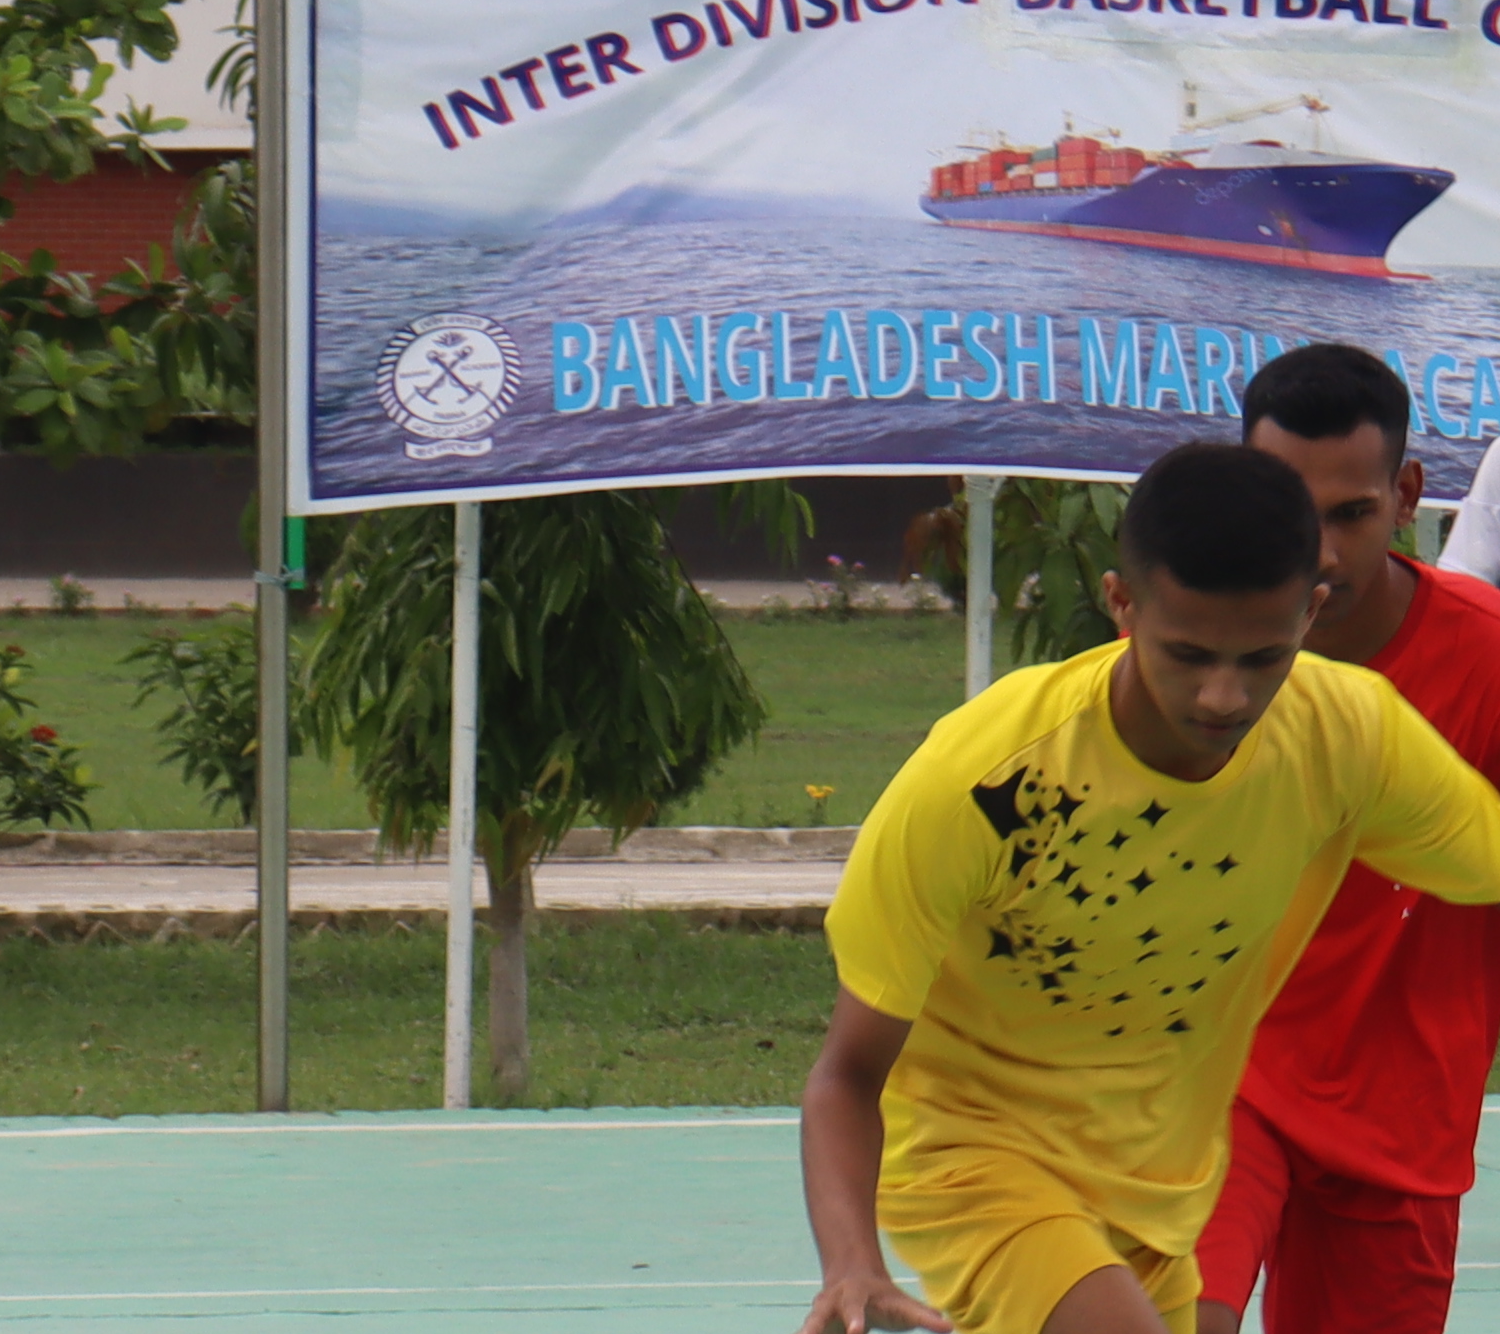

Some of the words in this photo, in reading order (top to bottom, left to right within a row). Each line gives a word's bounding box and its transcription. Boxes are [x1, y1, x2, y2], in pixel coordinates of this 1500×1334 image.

[422, 32, 644, 150] INTER
[552, 309, 1057, 413] BANGLADESH
[1078, 317, 1311, 419] MARI
